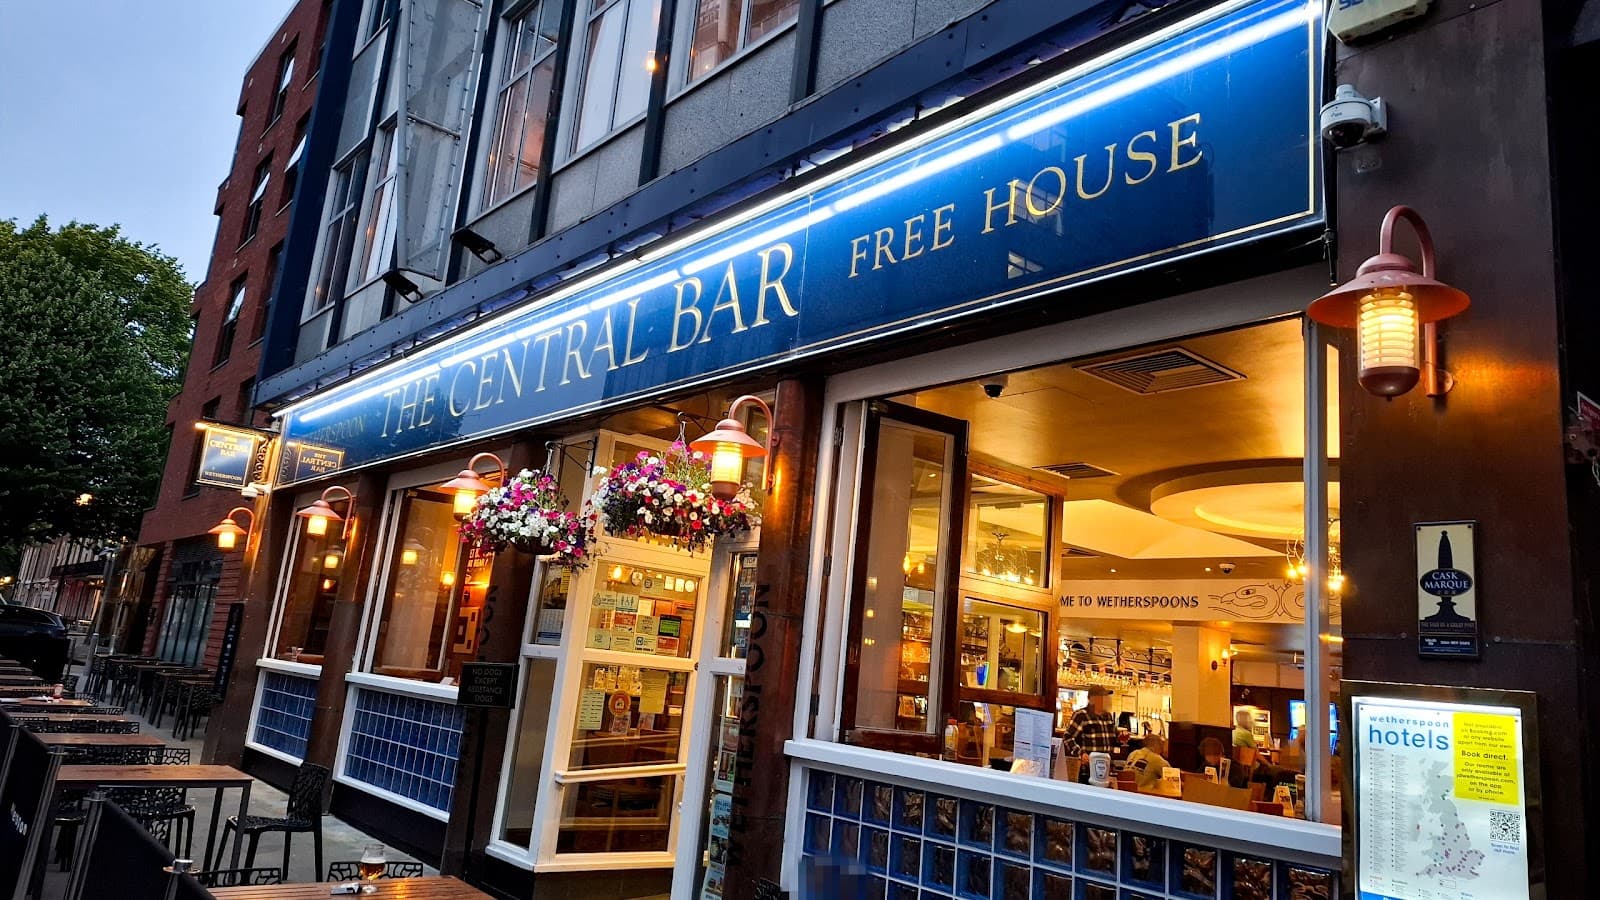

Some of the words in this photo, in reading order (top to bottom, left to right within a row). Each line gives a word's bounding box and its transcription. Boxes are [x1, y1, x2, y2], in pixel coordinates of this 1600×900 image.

[848, 203, 955, 278] FREE
[981, 112, 1203, 234] HOUSE
[381, 371, 439, 438] THE
[448, 298, 650, 417] CENTRAL
[667, 242, 798, 354] BAR
[209, 440, 248, 454] CENTRAL
[220, 449, 236, 457] BAR
[1431, 571, 1458, 581] CASK
[1424, 580, 1469, 590] MARQUE
[1078, 595, 1093, 607] TO
[1097, 595, 1199, 609] WETHERSPOONS
[472, 668, 483, 676] NO
[1370, 715, 1449, 728] wetherspoon
[1370, 725, 1449, 750] hotels
[1461, 750, 1481, 759] Book
[1483, 753, 1508, 761] direct.
